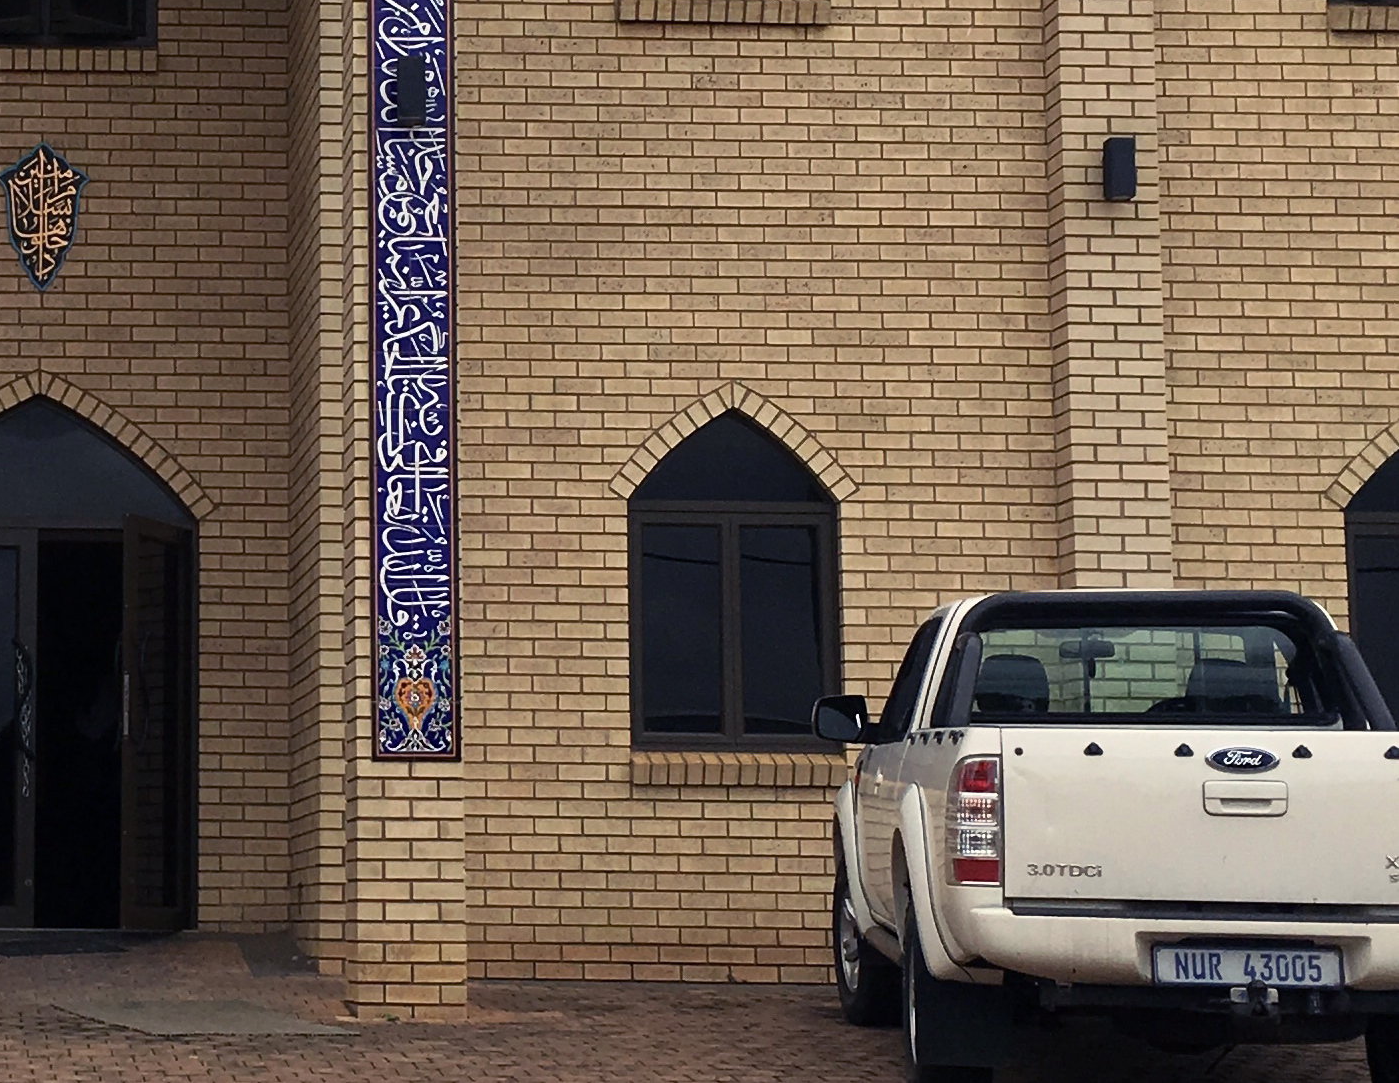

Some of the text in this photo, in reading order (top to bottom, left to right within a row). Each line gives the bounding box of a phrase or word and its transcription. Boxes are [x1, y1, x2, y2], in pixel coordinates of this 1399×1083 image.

[1223, 750, 1263, 767] Ford
[1175, 952, 1323, 985] NUR 43005
